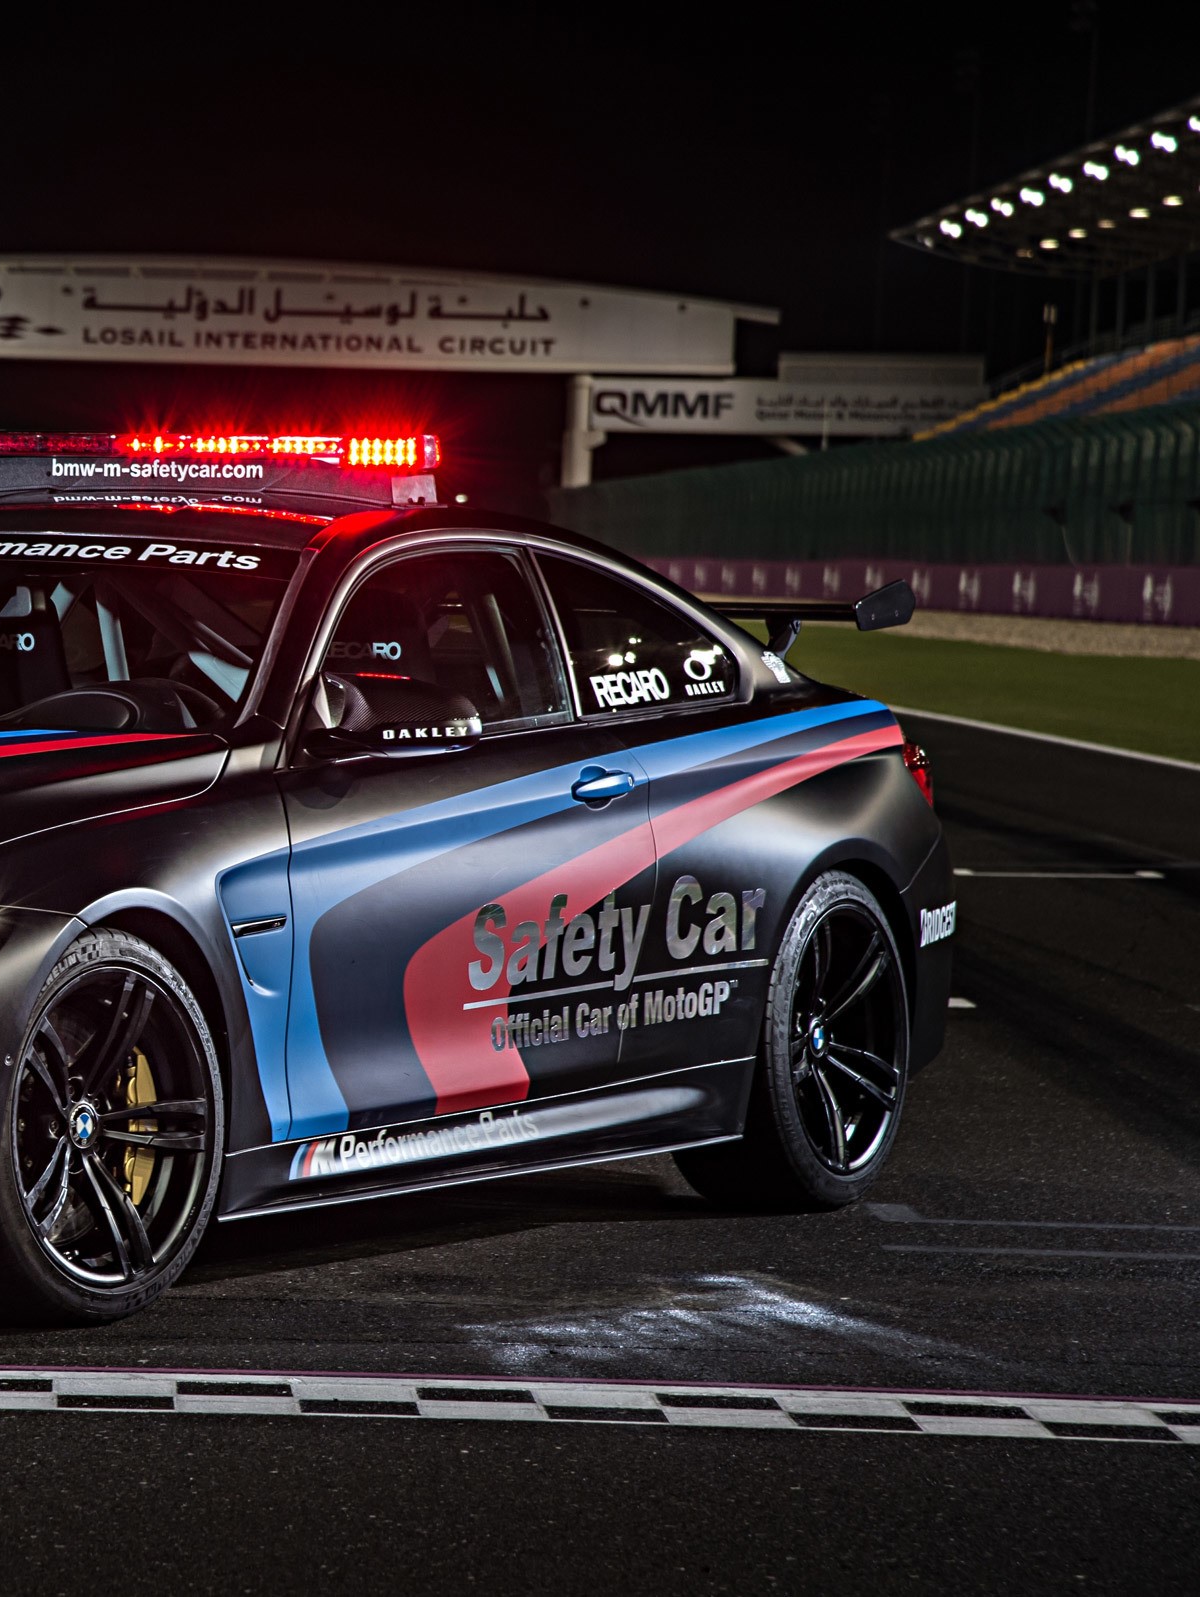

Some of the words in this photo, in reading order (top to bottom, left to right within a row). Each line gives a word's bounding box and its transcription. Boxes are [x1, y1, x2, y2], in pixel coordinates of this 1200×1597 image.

[82, 326, 184, 348] LOSAIL
[194, 330, 423, 354] INTERNATIONAL
[437, 335, 556, 356] CIRCUIT
[595, 390, 734, 426] QMMF
[51, 458, 263, 482] bmw-m-safetycar.com
[137, 543, 261, 570] Parts
[589, 667, 670, 708] RECARO
[685, 680, 725, 696] OAKLEY
[383, 727, 468, 740] OAKLEY
[468, 887, 652, 992] Safety
[666, 875, 767, 960] Car
[490, 1006, 569, 1053] Official
[575, 1002, 612, 1039] Car
[617, 994, 639, 1031] of
[340, 1123, 479, 1168] Performance
[478, 1110, 540, 1143] Parts
